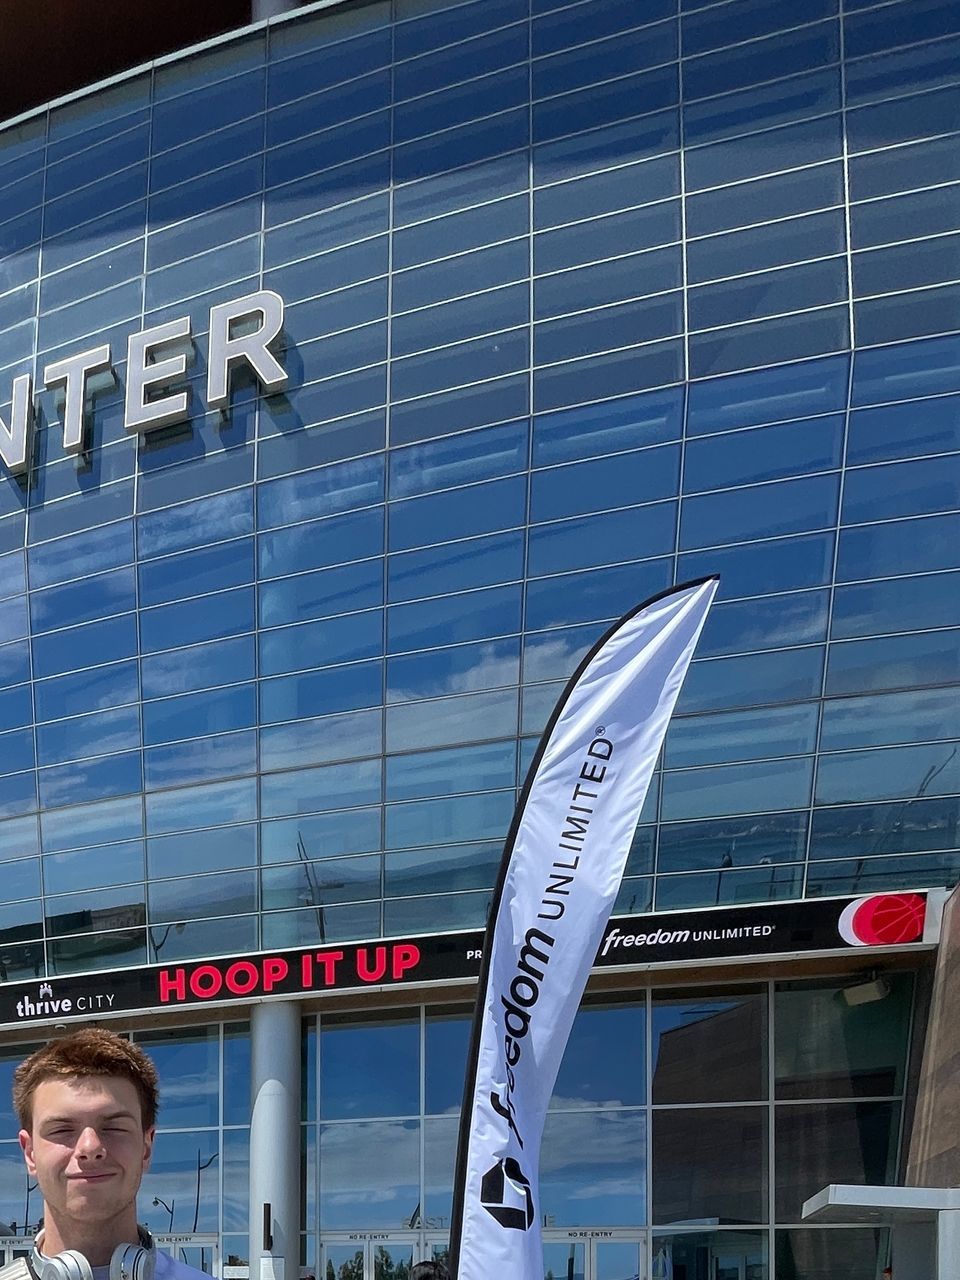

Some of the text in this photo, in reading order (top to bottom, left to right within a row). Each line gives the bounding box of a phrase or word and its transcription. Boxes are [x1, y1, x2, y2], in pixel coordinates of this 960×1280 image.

[601, 928, 690, 956] freedom
[159, 944, 420, 1002] HOOP IT UP
[16, 993, 115, 1017] thrive CITY
